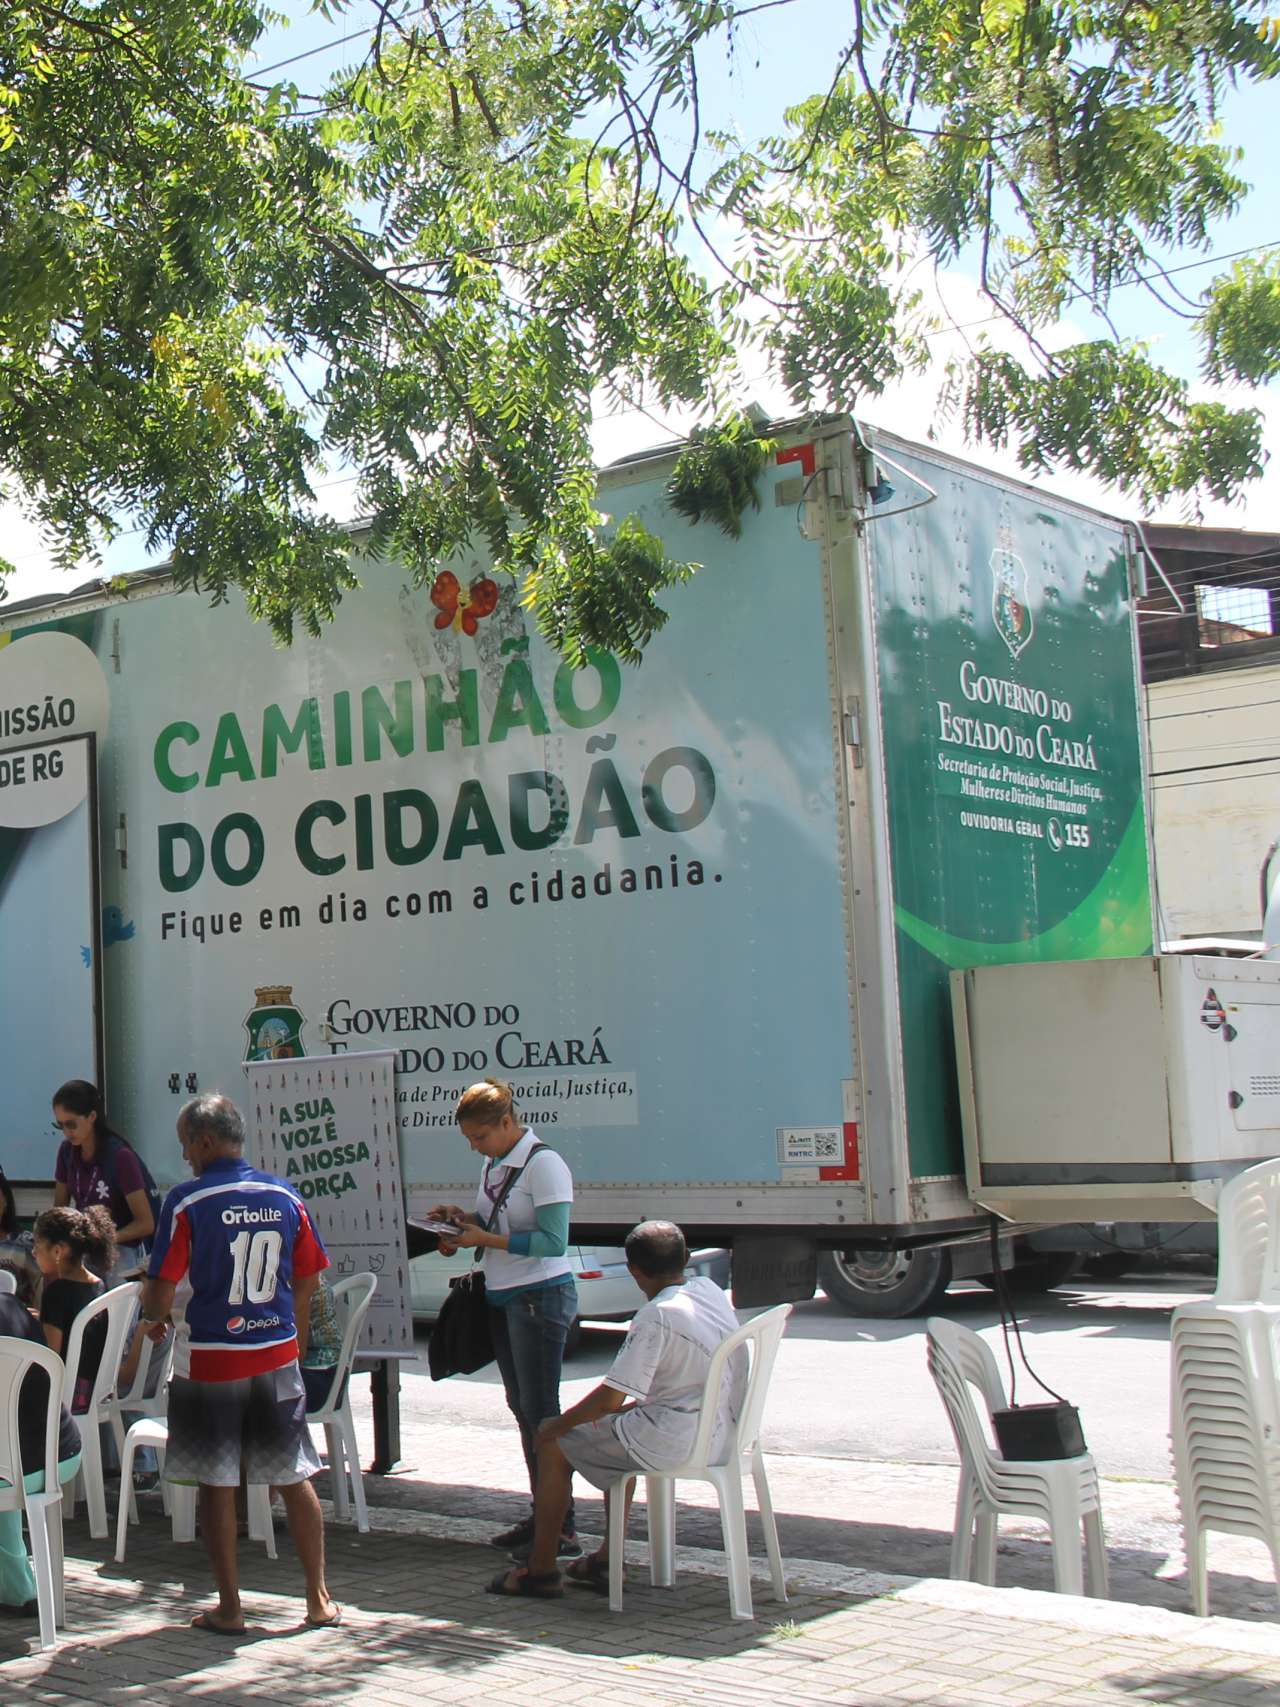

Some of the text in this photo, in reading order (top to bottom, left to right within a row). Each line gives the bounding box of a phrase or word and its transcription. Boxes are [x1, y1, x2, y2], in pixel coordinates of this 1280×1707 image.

[959, 660, 1071, 722] GOVERNO DO
[154, 637, 622, 793] CAMINHÃO
[937, 700, 1098, 771] ESTADO DO CEARÁ
[32, 749, 64, 782] RG
[937, 752, 1104, 803] Secretaria de Proteção Social, Justiça,
[157, 732, 716, 893] DO CIDADÃO
[960, 777, 1088, 816] Mulheres e Direitos Humanos
[960, 810, 1090, 848] OUVIDORIA GERAL 155
[161, 854, 723, 943] Fique em dia com a cidadania.
[326, 999, 519, 1035] GOVERNO DO
[452, 1049, 488, 1071] DO
[495, 1026, 612, 1069] CEARÁ
[411, 1085, 428, 1102] de
[566, 1078, 633, 1100] Justiça,
[280, 1097, 335, 1126] A SUA
[519, 1110, 558, 1124] anos
[281, 1117, 338, 1151] VOZ É
[287, 1141, 370, 1177] A NOSSA
[221, 1207, 282, 1225] Ortolite
[228, 1230, 283, 1305] 10
[246, 1315, 280, 1331] pepsi
